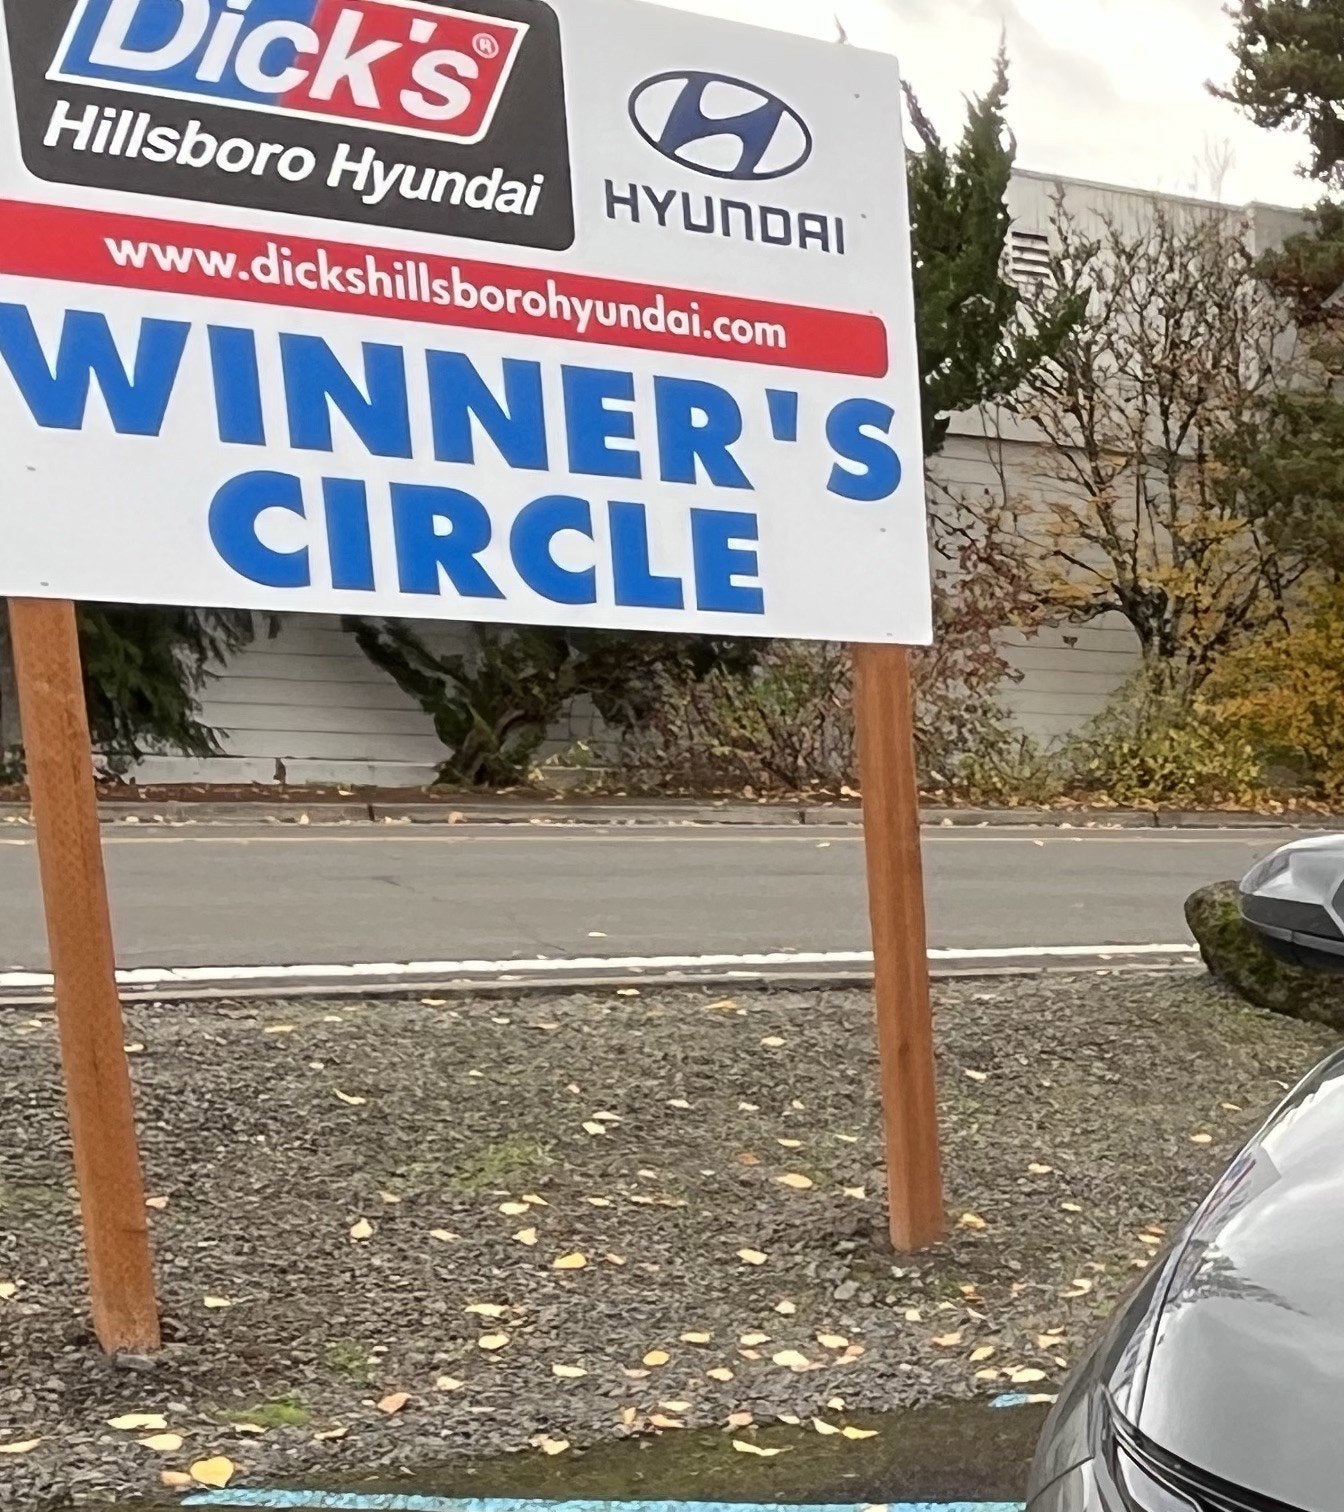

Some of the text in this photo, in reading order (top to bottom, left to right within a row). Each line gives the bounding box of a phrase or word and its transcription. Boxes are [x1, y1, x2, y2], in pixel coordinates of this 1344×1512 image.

[43, 100, 544, 216] Hillsboro Hyundai
[604, 179, 846, 255] HYUNDAI
[104, 235, 787, 349] www.dickshillsborohyundai.com
[0, 302, 903, 502] WINNER'S
[208, 470, 766, 615] CIRCLE
